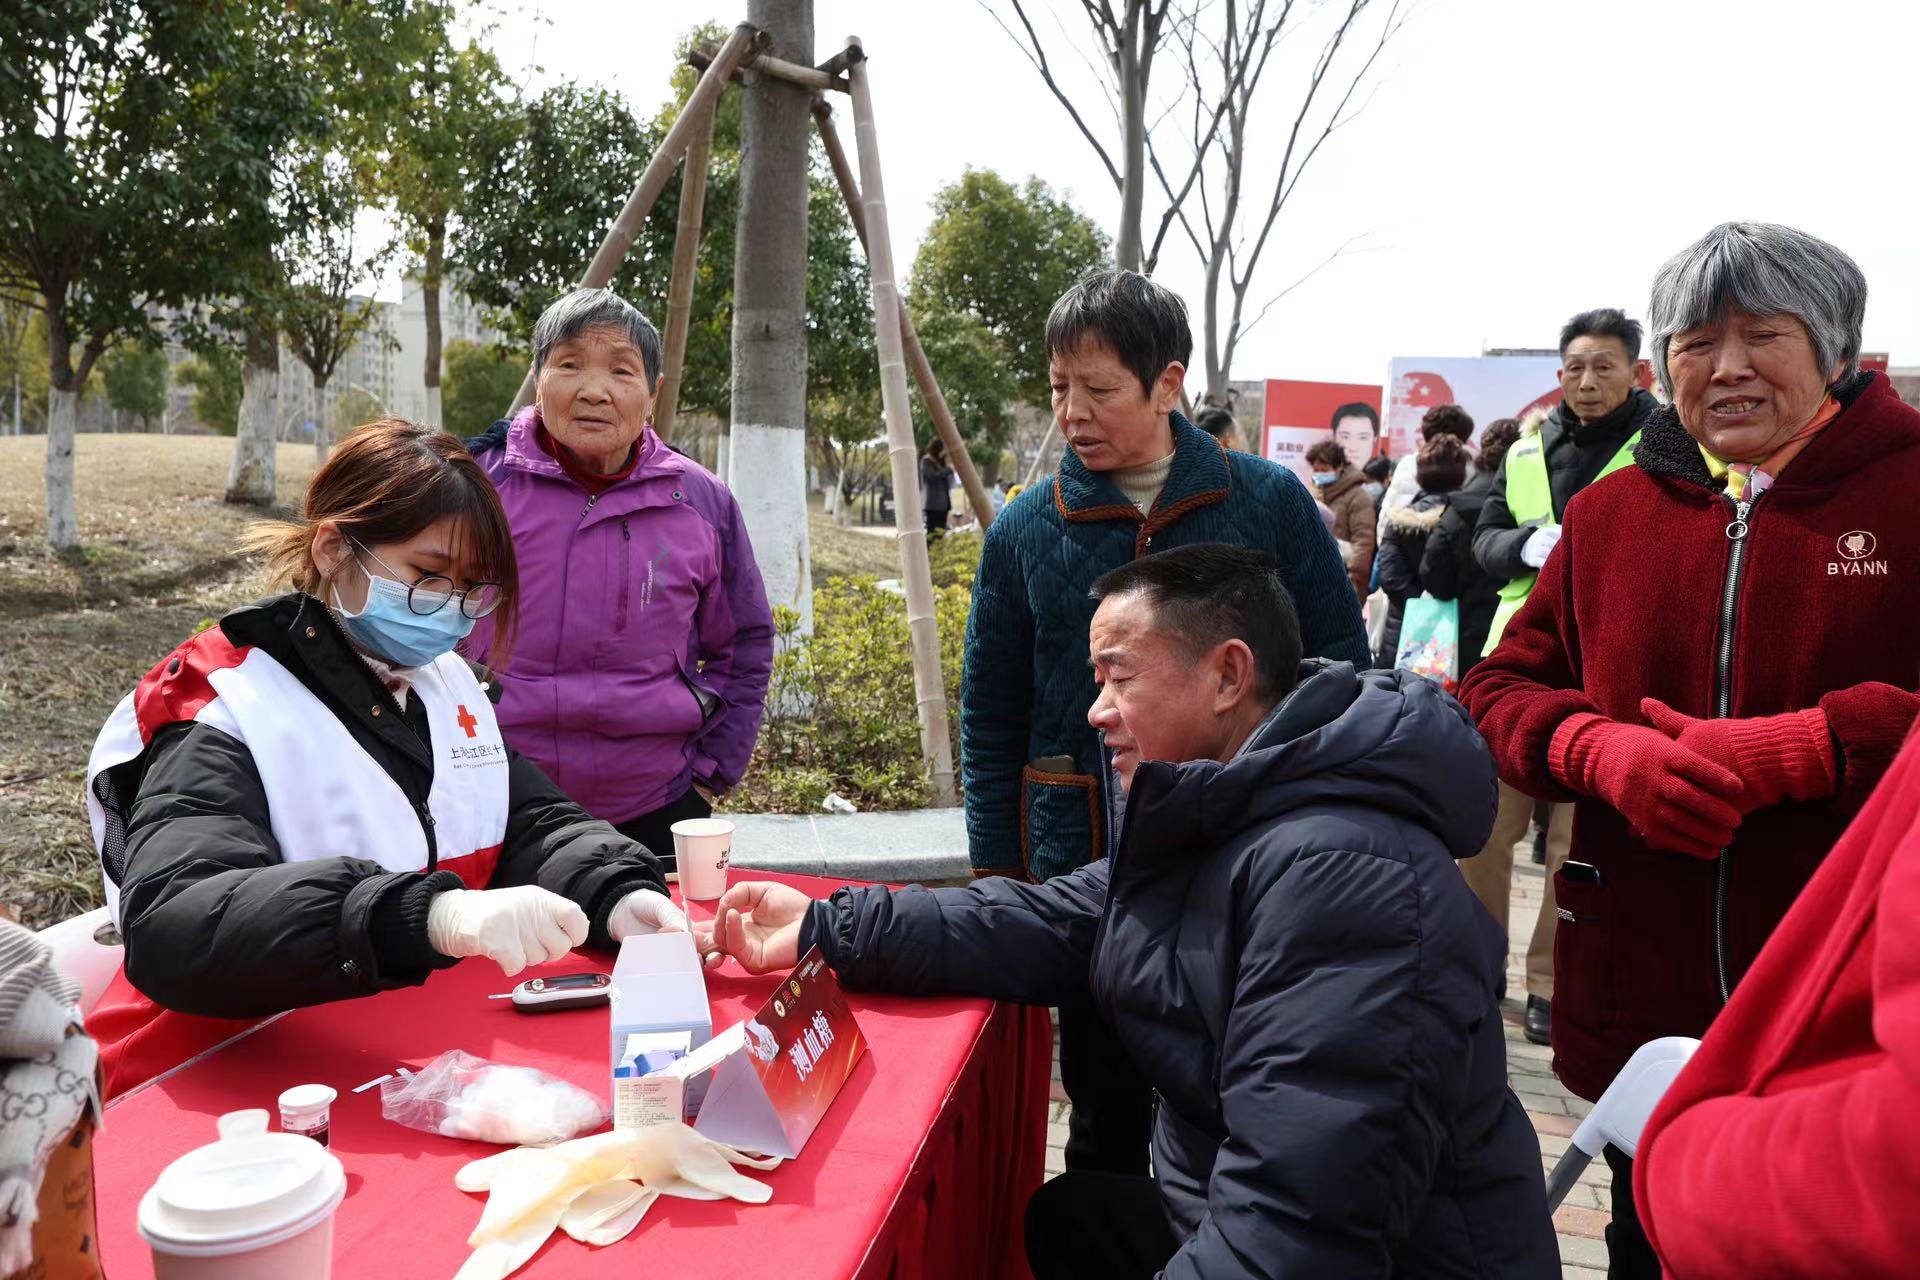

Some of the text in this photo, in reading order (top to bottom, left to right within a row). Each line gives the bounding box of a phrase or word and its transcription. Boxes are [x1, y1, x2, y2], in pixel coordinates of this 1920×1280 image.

[1827, 560, 1888, 576] BYANN
[788, 1009, 835, 1082] 测血糖
